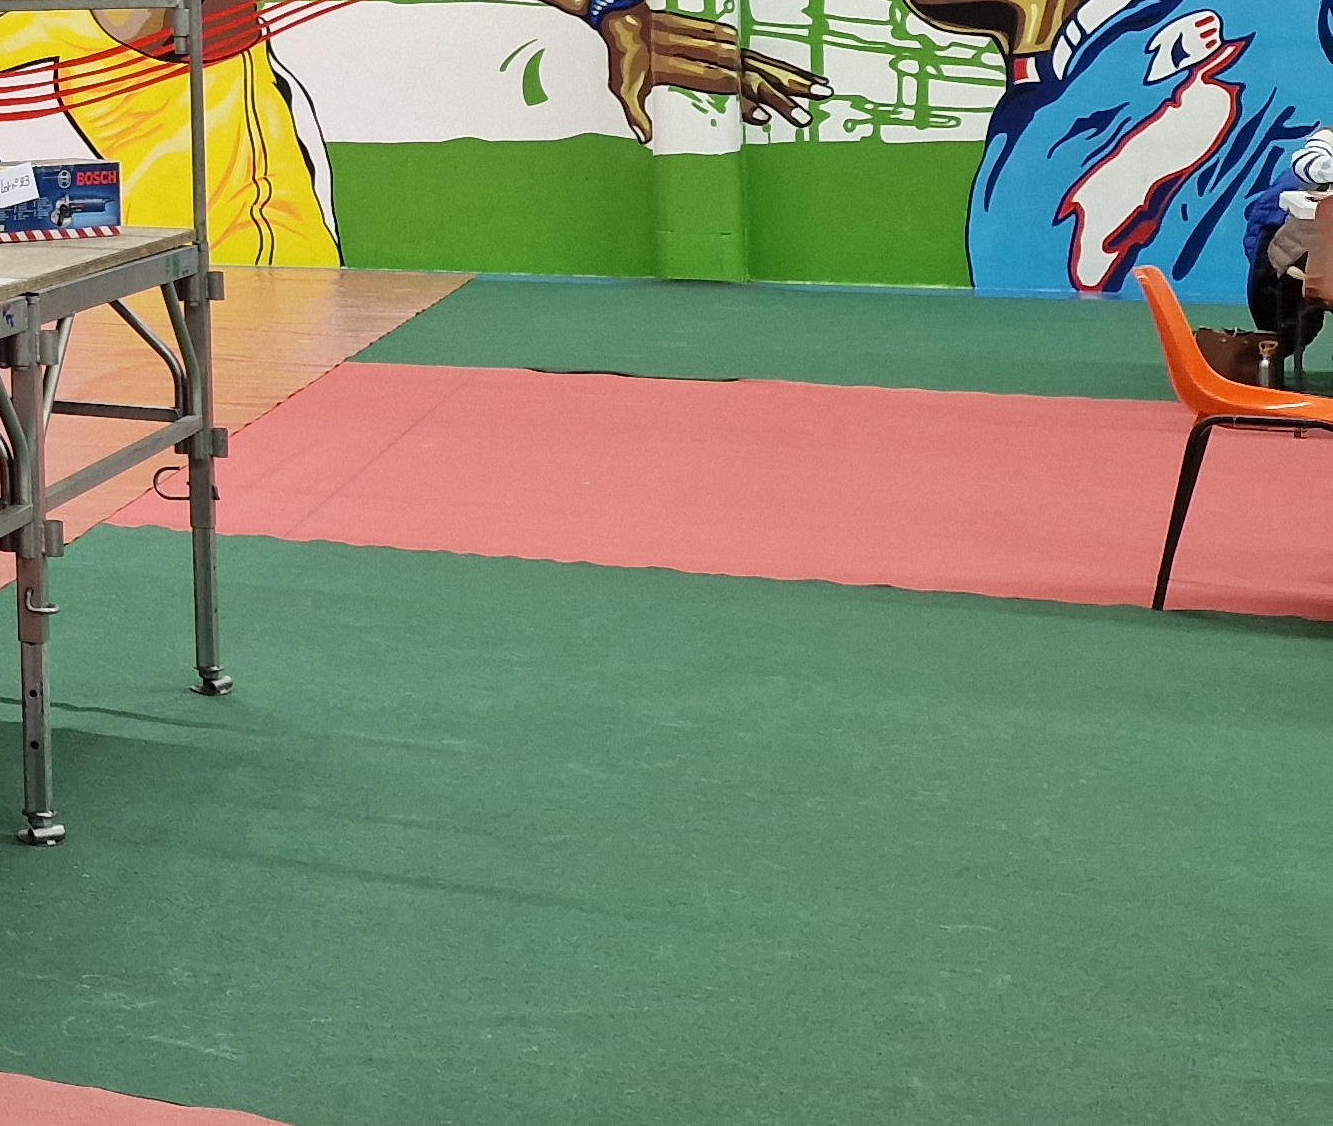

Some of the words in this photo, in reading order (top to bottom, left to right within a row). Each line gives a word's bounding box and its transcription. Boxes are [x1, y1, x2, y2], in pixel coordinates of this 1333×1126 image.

[0, 180, 12, 195] Lot
[19, 175, 31, 188] 23
[75, 170, 117, 186] BOSCH
